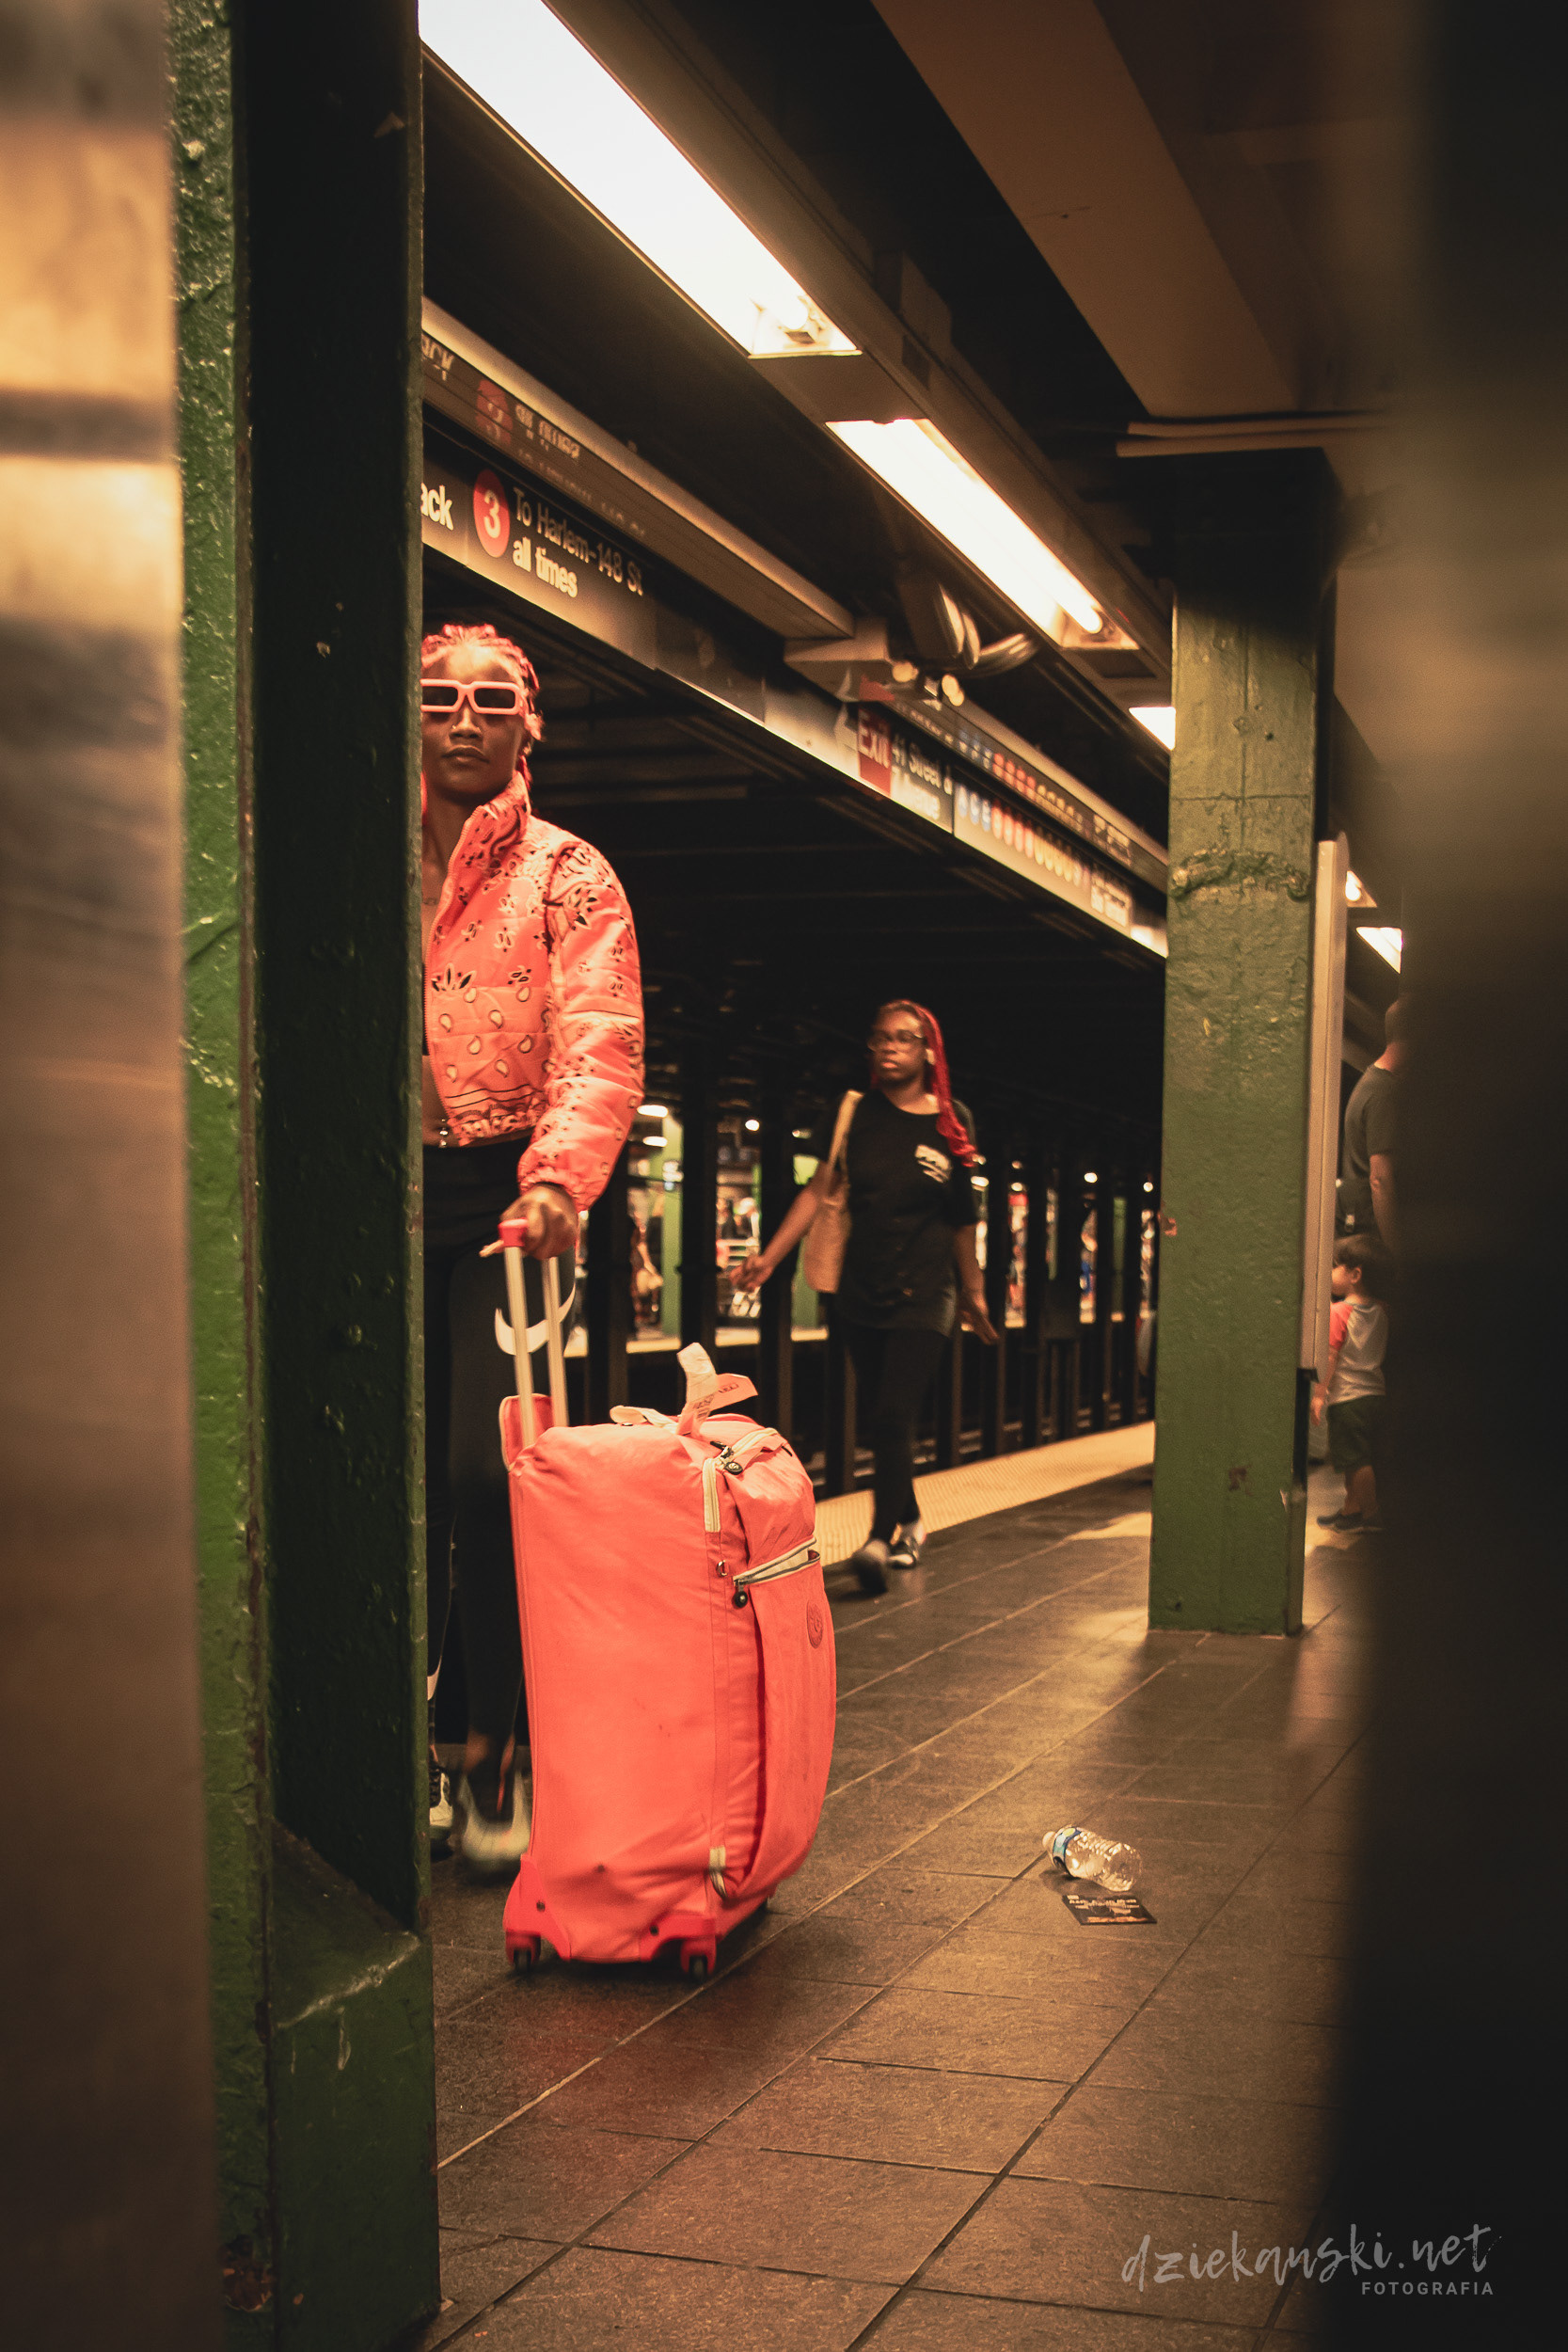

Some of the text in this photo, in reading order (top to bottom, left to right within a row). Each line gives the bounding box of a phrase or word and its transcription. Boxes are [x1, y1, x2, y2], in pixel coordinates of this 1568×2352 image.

[483, 490, 501, 538] 3
[514, 487, 532, 527] To
[536, 502, 623, 583] Harlem-148
[626, 562, 644, 596] St
[513, 536, 578, 597] all times
